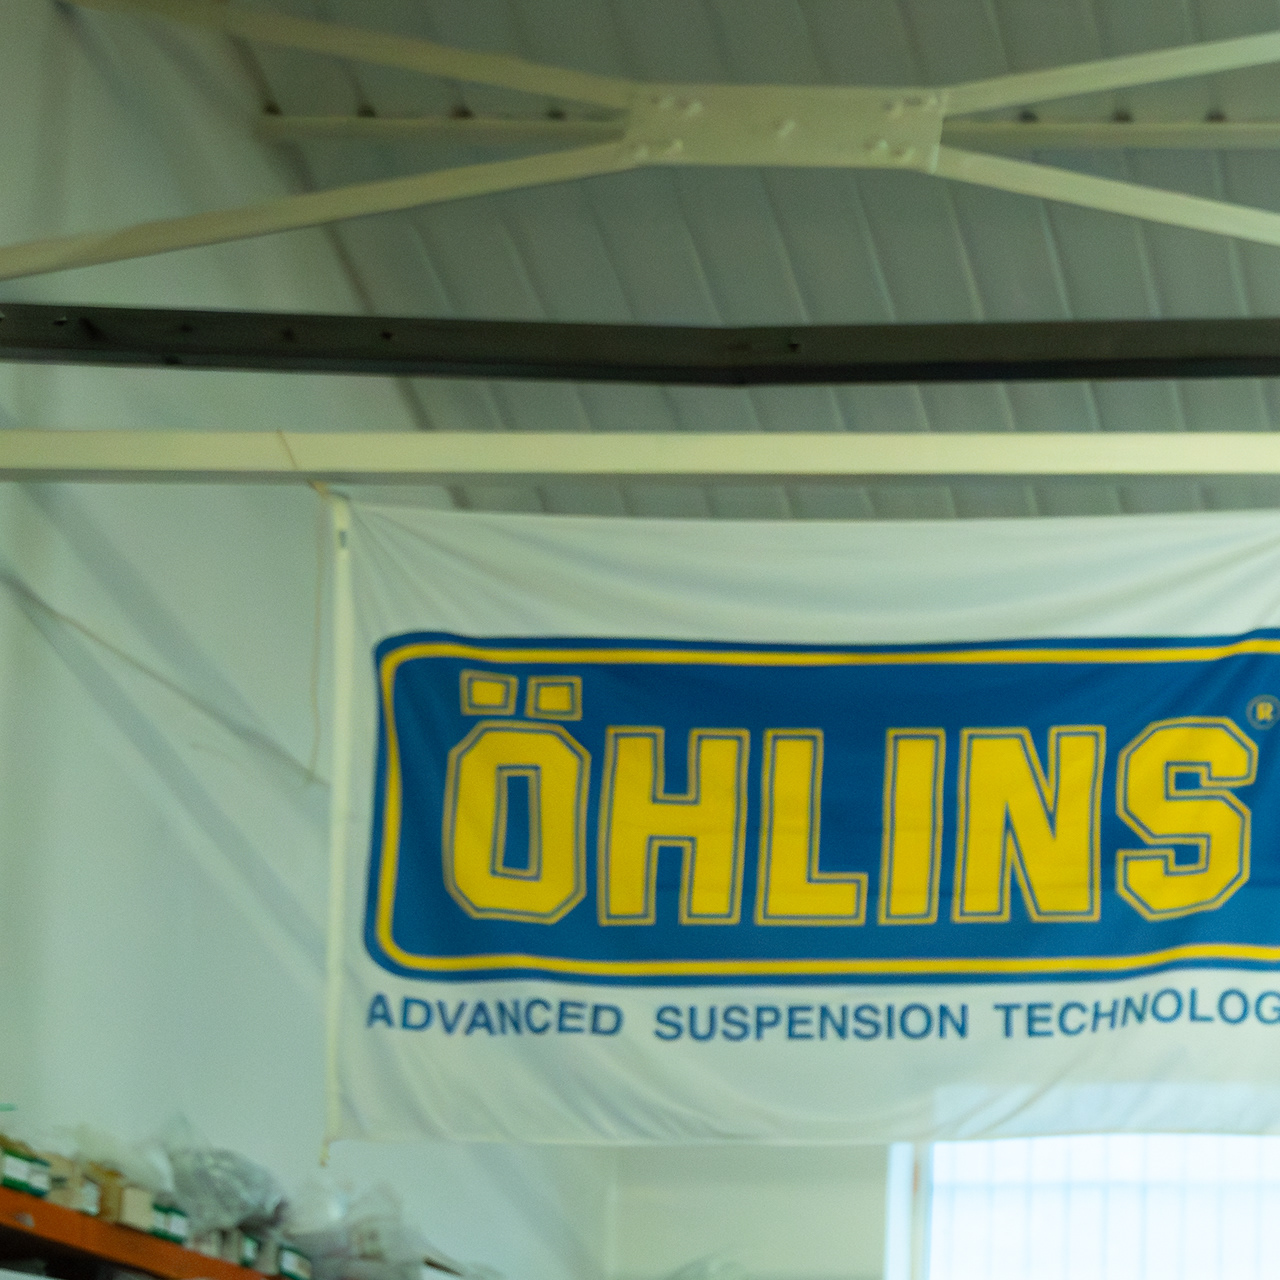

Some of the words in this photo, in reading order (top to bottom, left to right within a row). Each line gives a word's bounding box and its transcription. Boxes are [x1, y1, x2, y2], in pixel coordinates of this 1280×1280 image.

[442, 669, 1258, 926] ÖHLINS
[365, 993, 625, 1036] ADVANCED
[653, 1002, 969, 1042] SUSPENSION
